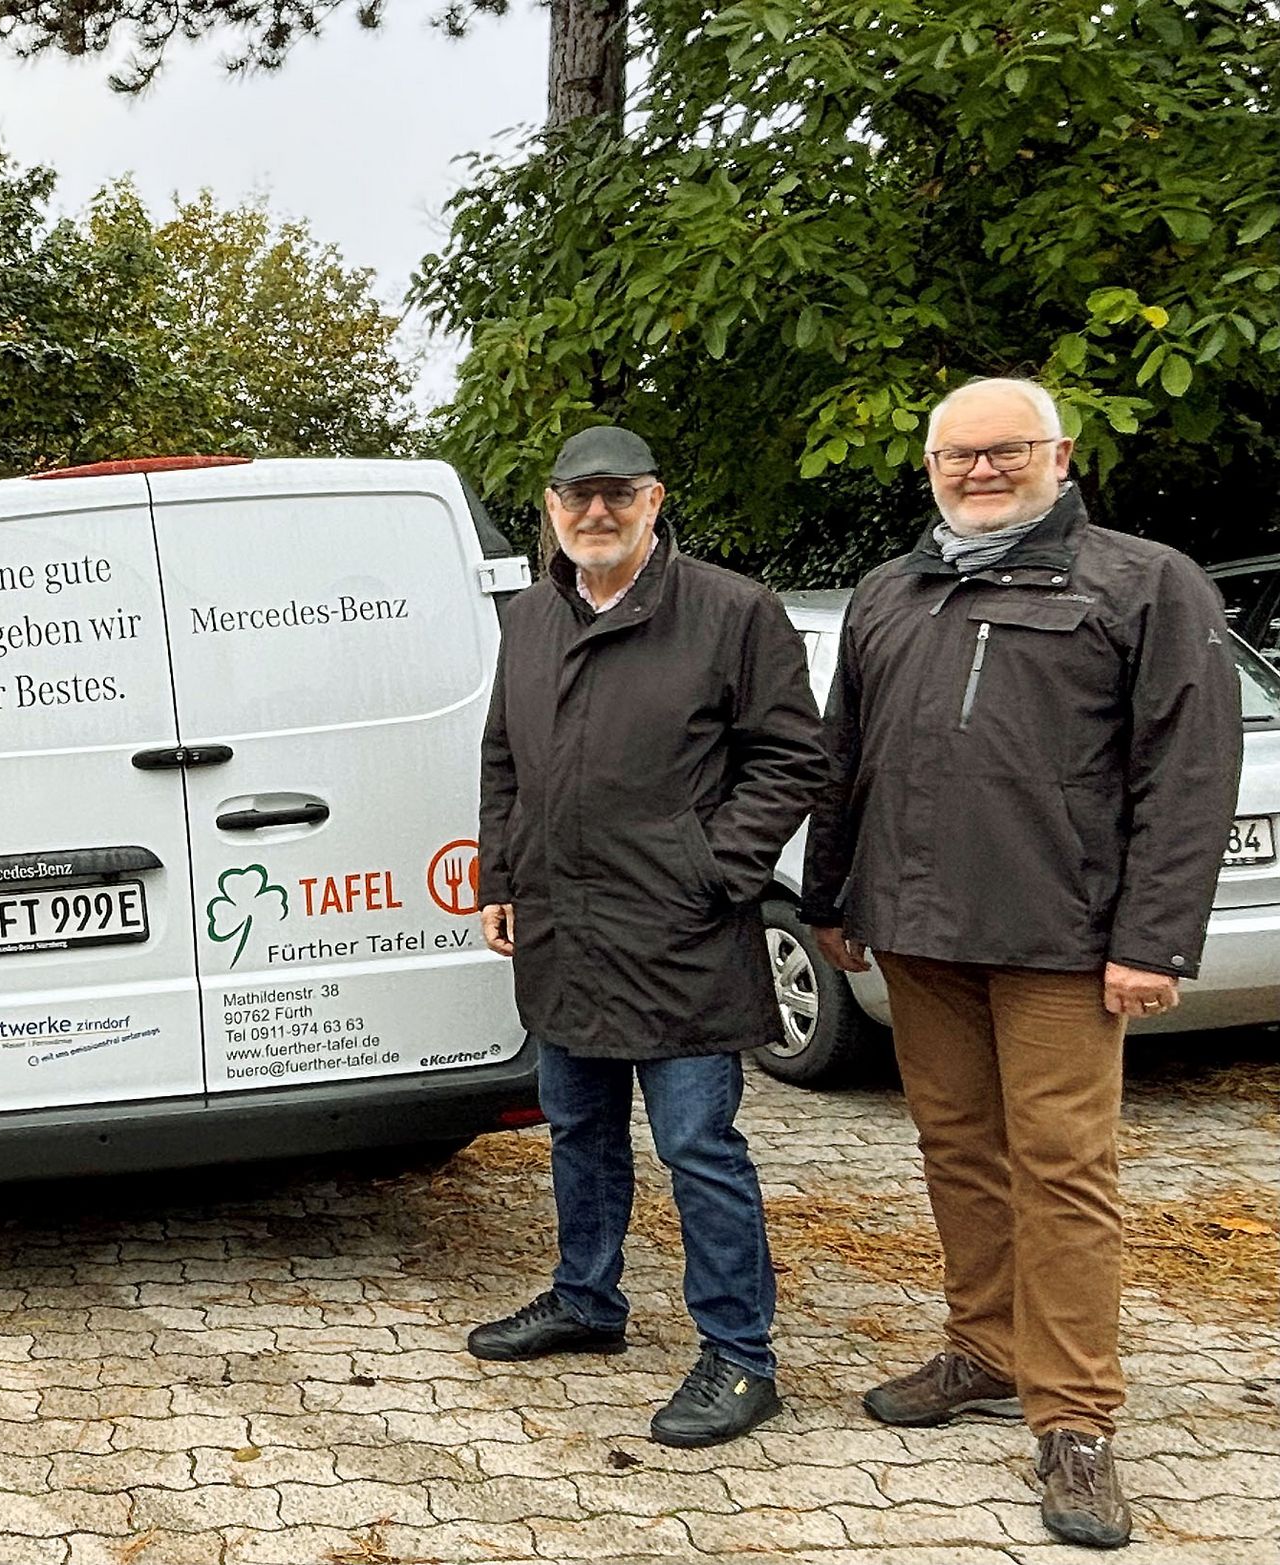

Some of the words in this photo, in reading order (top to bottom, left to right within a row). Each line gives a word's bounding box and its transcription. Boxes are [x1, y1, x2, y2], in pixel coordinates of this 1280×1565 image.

[45, 555, 112, 596] gute
[89, 608, 142, 641] wir
[190, 595, 409, 636] Mercedes-Benz
[15, 674, 126, 708] Bestes.
[299, 871, 403, 917] TAFEL
[0, 899, 40, 938] FT
[268, 939, 359, 963] Fürther
[367, 930, 425, 954] Tafel
[434, 929, 473, 949] e.V.
[320, 984, 339, 998] 38
[77, 1015, 131, 1032] zirndorf
[224, 1009, 270, 1025] 90762
[275, 1005, 313, 1021] Fürth
[225, 1029, 246, 1043] Tel
[251, 1022, 319, 1041] 0911-974
[323, 1020, 341, 1034] 63
[346, 1017, 364, 1031] 63
[226, 1035, 380, 1061] www.fuerther-tafel.de
[226, 1051, 400, 1079] buero@fuerther-tafel.de
